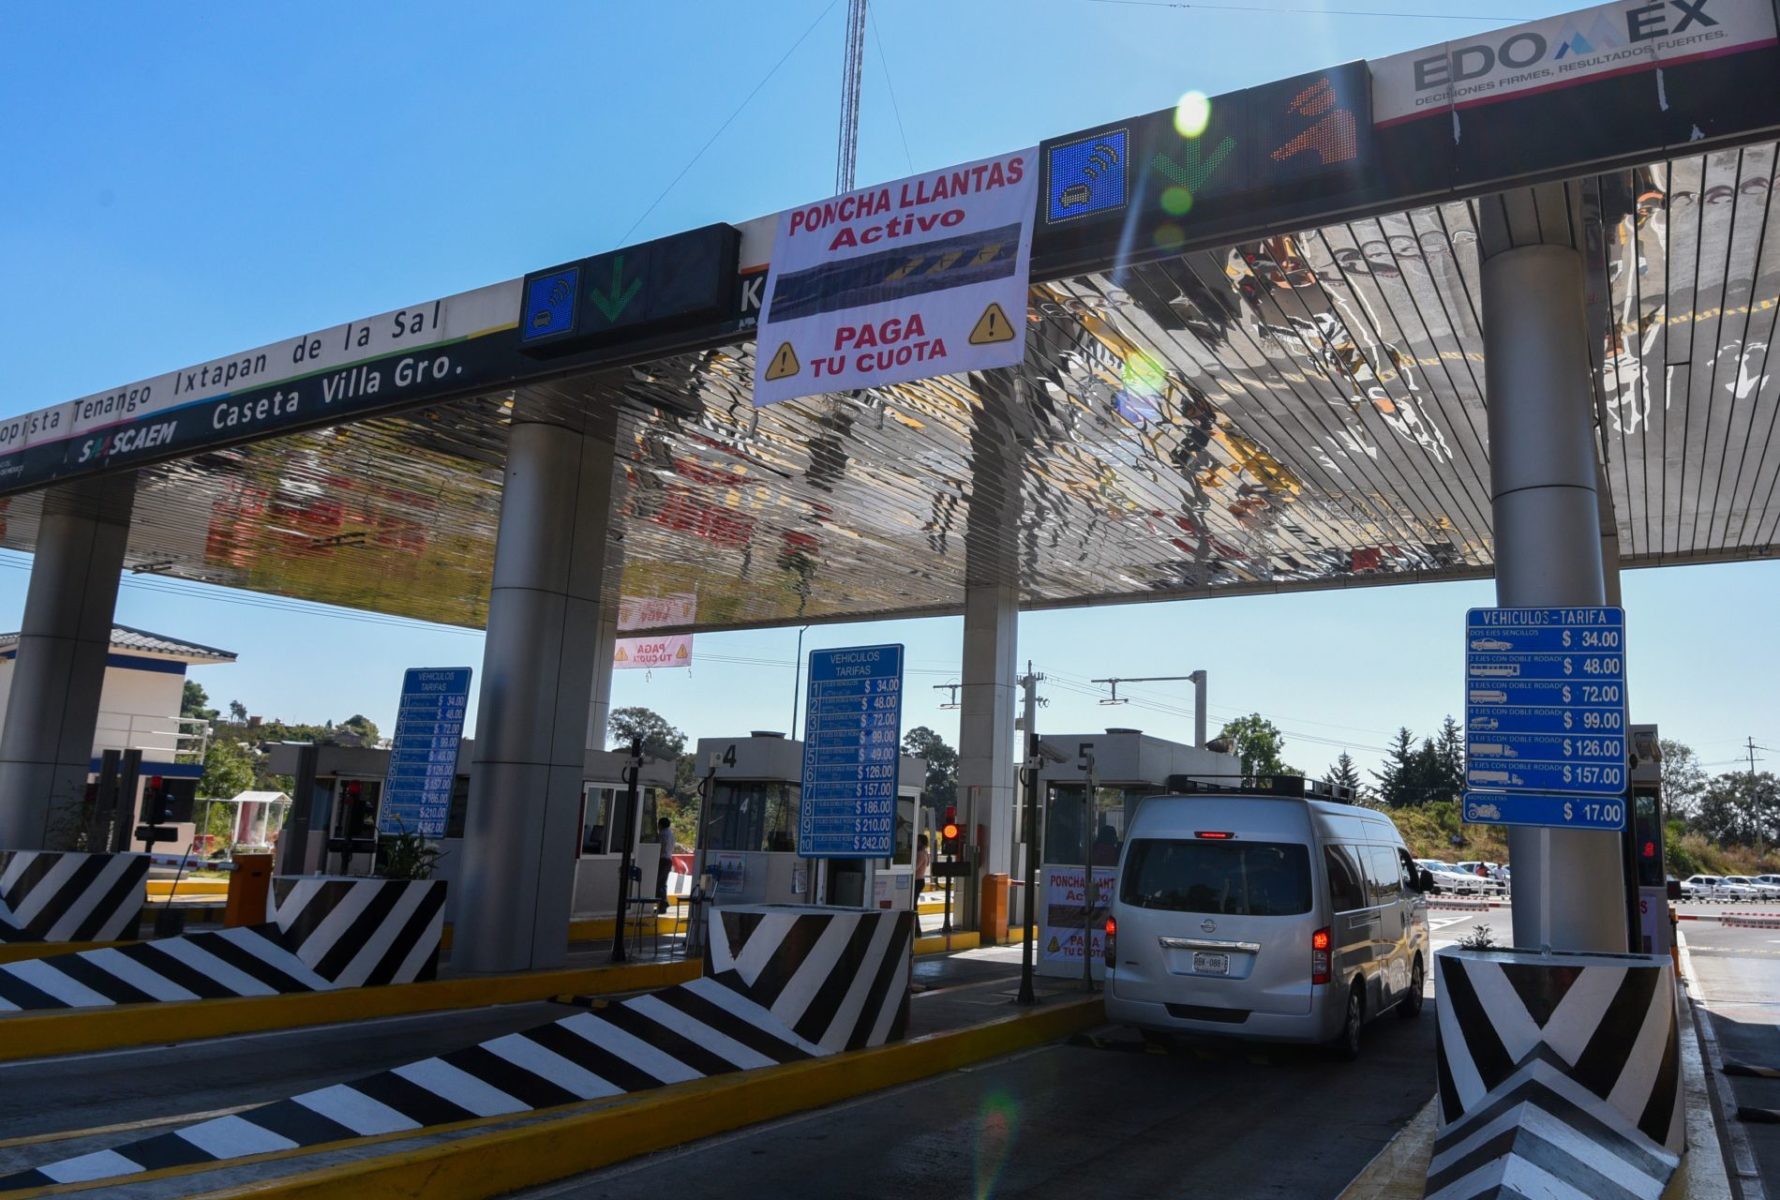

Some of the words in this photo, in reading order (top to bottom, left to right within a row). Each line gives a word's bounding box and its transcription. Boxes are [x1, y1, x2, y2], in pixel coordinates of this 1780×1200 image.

[1415, 81, 1495, 106] DECISIONES
[1500, 68, 1554, 88] FIRMES,
[1559, 44, 1655, 73] RESULTADOS
[789, 188, 891, 237] PONCHA
[899, 157, 1024, 209] LLANTAS
[828, 208, 966, 251] Activo
[834, 313, 925, 351] PAGA
[73, 382, 151, 422] Tenango
[174, 352, 267, 395] Ixtapan
[292, 335, 322, 364] de
[344, 323, 371, 351] la
[391, 300, 441, 338] Sal
[810, 355, 845, 378] TU
[855, 338, 947, 373] CUOTA
[212, 389, 299, 429] Caseta
[322, 367, 380, 403] Villa
[394, 354, 463, 387] Gro.
[1562, 630, 1571, 648] $
[1582, 631, 1618, 647] 34.00
[831, 650, 880, 664] VEHICULOS
[836, 665, 871, 676] TARIFAS
[1564, 657, 1572, 675] $
[1583, 658, 1620, 674] 48.00
[812, 683, 818, 696] 1
[864, 679, 870, 693] $
[876, 679, 899, 692] 34.00
[1562, 685, 1571, 703] $
[1582, 686, 1618, 702] 72.00
[811, 699, 817, 713] 2
[861, 697, 867, 710] $
[874, 696, 896, 709] 48.00
[810, 716, 816, 730] 3
[860, 714, 866, 727] $
[873, 713, 895, 726] 72.00
[1564, 711, 1572, 729] $
[1583, 712, 1620, 729] 99.00
[808, 733, 815, 746] 4
[860, 731, 865, 744] $
[1563, 738, 1572, 756] $
[1576, 740, 1620, 756] 126.00
[722, 744, 736, 768] 4
[807, 750, 814, 764] 5
[859, 748, 865, 762] $
[1077, 743, 1094, 770] 5
[806, 767, 813, 781] 6
[857, 766, 863, 779] $
[1563, 765, 1572, 783] $
[1576, 767, 1620, 784] 157.00
[805, 784, 812, 798] 7
[856, 783, 862, 796] $
[864, 783, 891, 796] 157.00
[740, 798, 749, 814] 4
[804, 802, 812, 816] 8
[855, 801, 861, 814] $
[1564, 802, 1573, 820] $
[1584, 805, 1620, 821] 17.00
[803, 819, 810, 833] 9
[855, 819, 861, 832] $
[862, 818, 890, 831] 210.00
[853, 836, 859, 850] $
[861, 836, 890, 849] 242.00
[1050, 875, 1085, 888] PONCHA
[1070, 935, 1099, 948] PAA
[1063, 947, 1075, 956] TU
